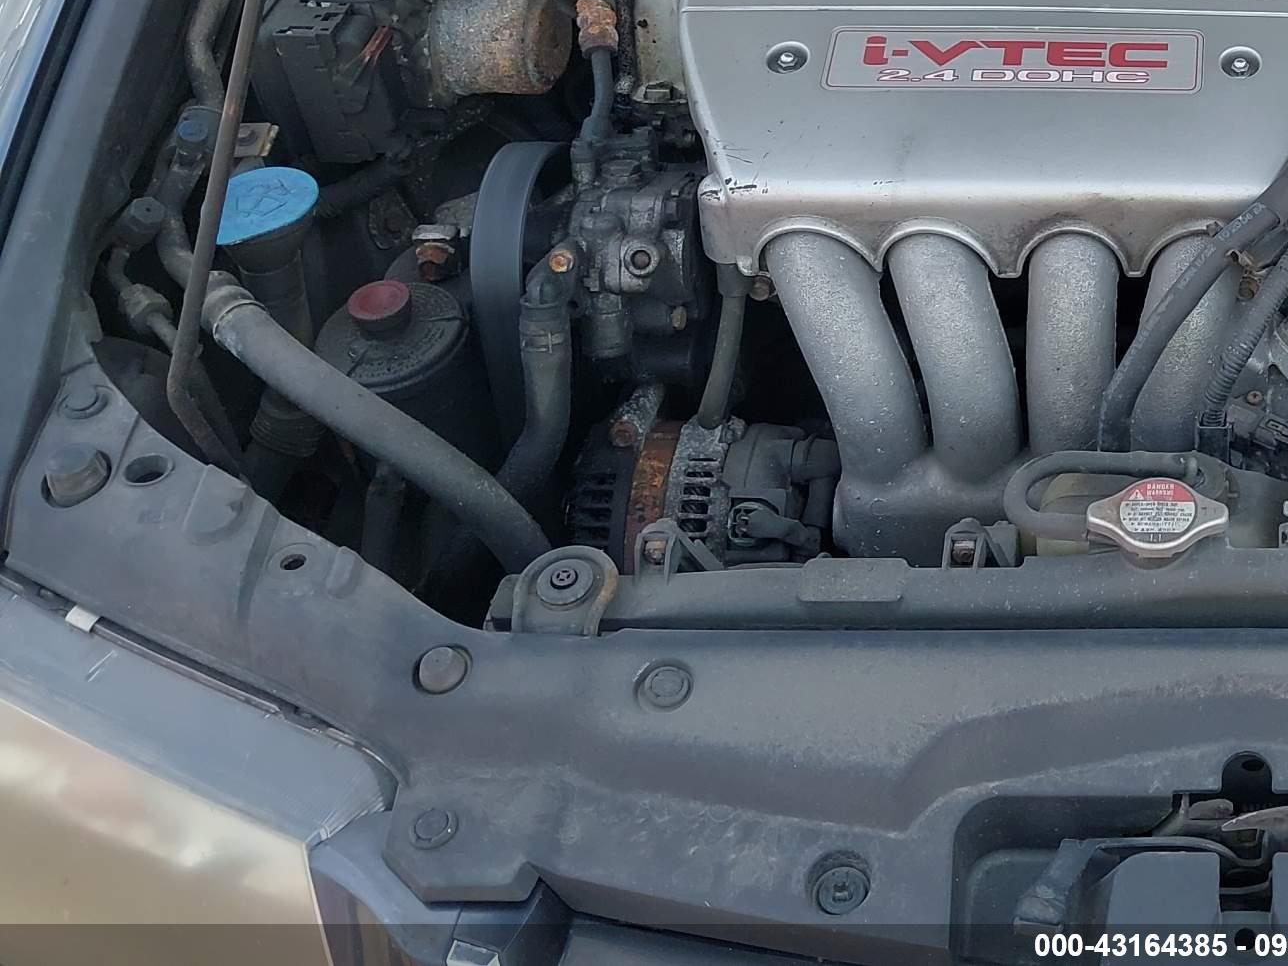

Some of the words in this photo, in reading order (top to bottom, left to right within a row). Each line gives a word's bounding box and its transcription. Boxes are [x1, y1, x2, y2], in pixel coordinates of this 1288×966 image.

[863, 35, 1169, 68] i-VTEC
[876, 68, 960, 83] 2.4
[970, 69, 1151, 85] DOHC
